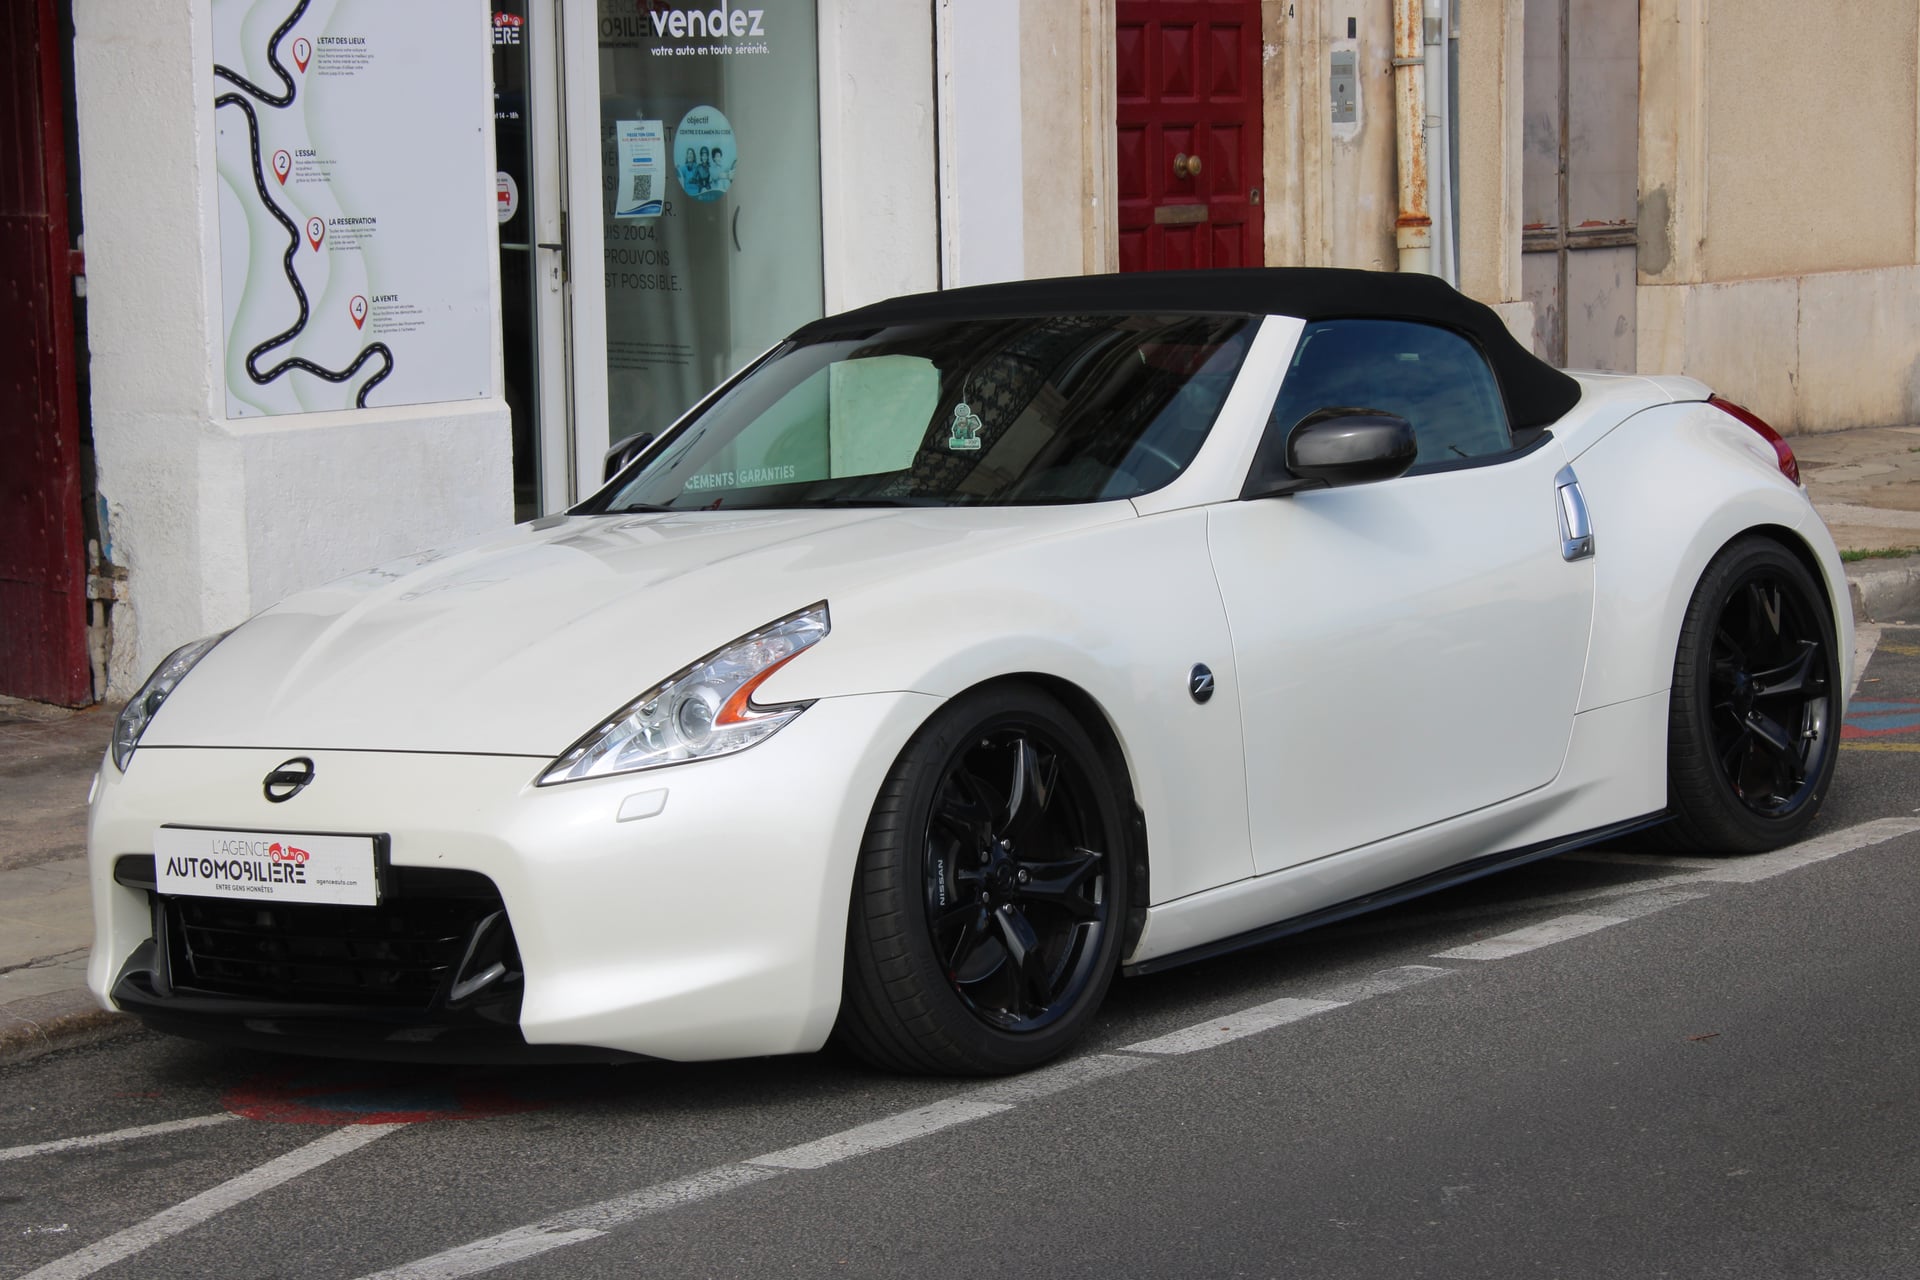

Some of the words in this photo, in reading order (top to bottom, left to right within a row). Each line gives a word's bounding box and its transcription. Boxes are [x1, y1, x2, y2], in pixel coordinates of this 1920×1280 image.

[1288, 3, 1295, 18] 4
[650, 0, 765, 38] vendez
[317, 37, 335, 45] L'ETAT
[335, 37, 348, 45] DES
[348, 37, 366, 45] LIEUX
[299, 43, 304, 57] 1
[651, 45, 674, 56] votre
[675, 45, 696, 56] auto
[697, 46, 708, 55] en
[710, 44, 733, 55] toute
[735, 41, 770, 55] sérénité.
[686, 115, 709, 126] objectif
[295, 149, 317, 157] L'ESSAI
[279, 155, 286, 169] 2
[328, 218, 337, 226] LA
[336, 216, 377, 225] RESERVATION
[312, 222, 320, 236] 3
[623, 225, 658, 243] 2004,
[621, 273, 683, 291] POSSIBLE.
[372, 295, 380, 303] LA
[380, 294, 399, 302] VENTE
[355, 301, 362, 313] 4
[740, 465, 795, 483] GARANTIES
[212, 839, 269, 857] L'AGENCE
[232, 884, 246, 892] GENS
[937, 859, 945, 906] NISSAN
